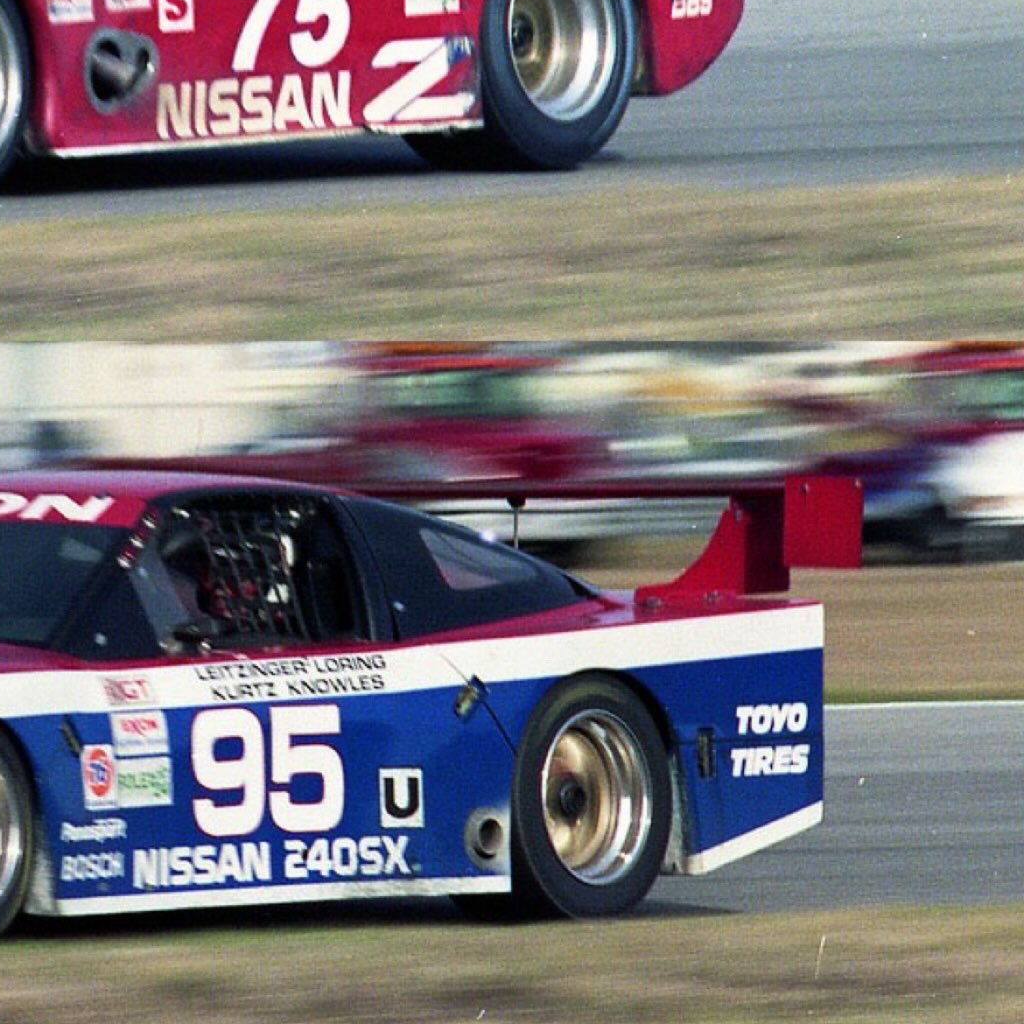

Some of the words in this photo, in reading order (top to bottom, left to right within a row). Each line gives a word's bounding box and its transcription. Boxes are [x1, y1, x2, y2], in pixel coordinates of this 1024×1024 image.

[156, 71, 352, 141] NISSAN
[363, 36, 475, 122] Z
[194, 658, 308, 682] LEITZINGER
[314, 654, 387, 673] LORING
[211, 682, 276, 701] KURTZ
[287, 674, 385, 696] KNOWLES
[736, 702, 808, 735] TOYO
[190, 703, 346, 837] 95
[730, 744, 810, 778] TIRES
[384, 777, 421, 819] U
[59, 851, 126, 882] BOSCH
[132, 842, 272, 890] NISSAN
[283, 836, 412, 879] 240SX
